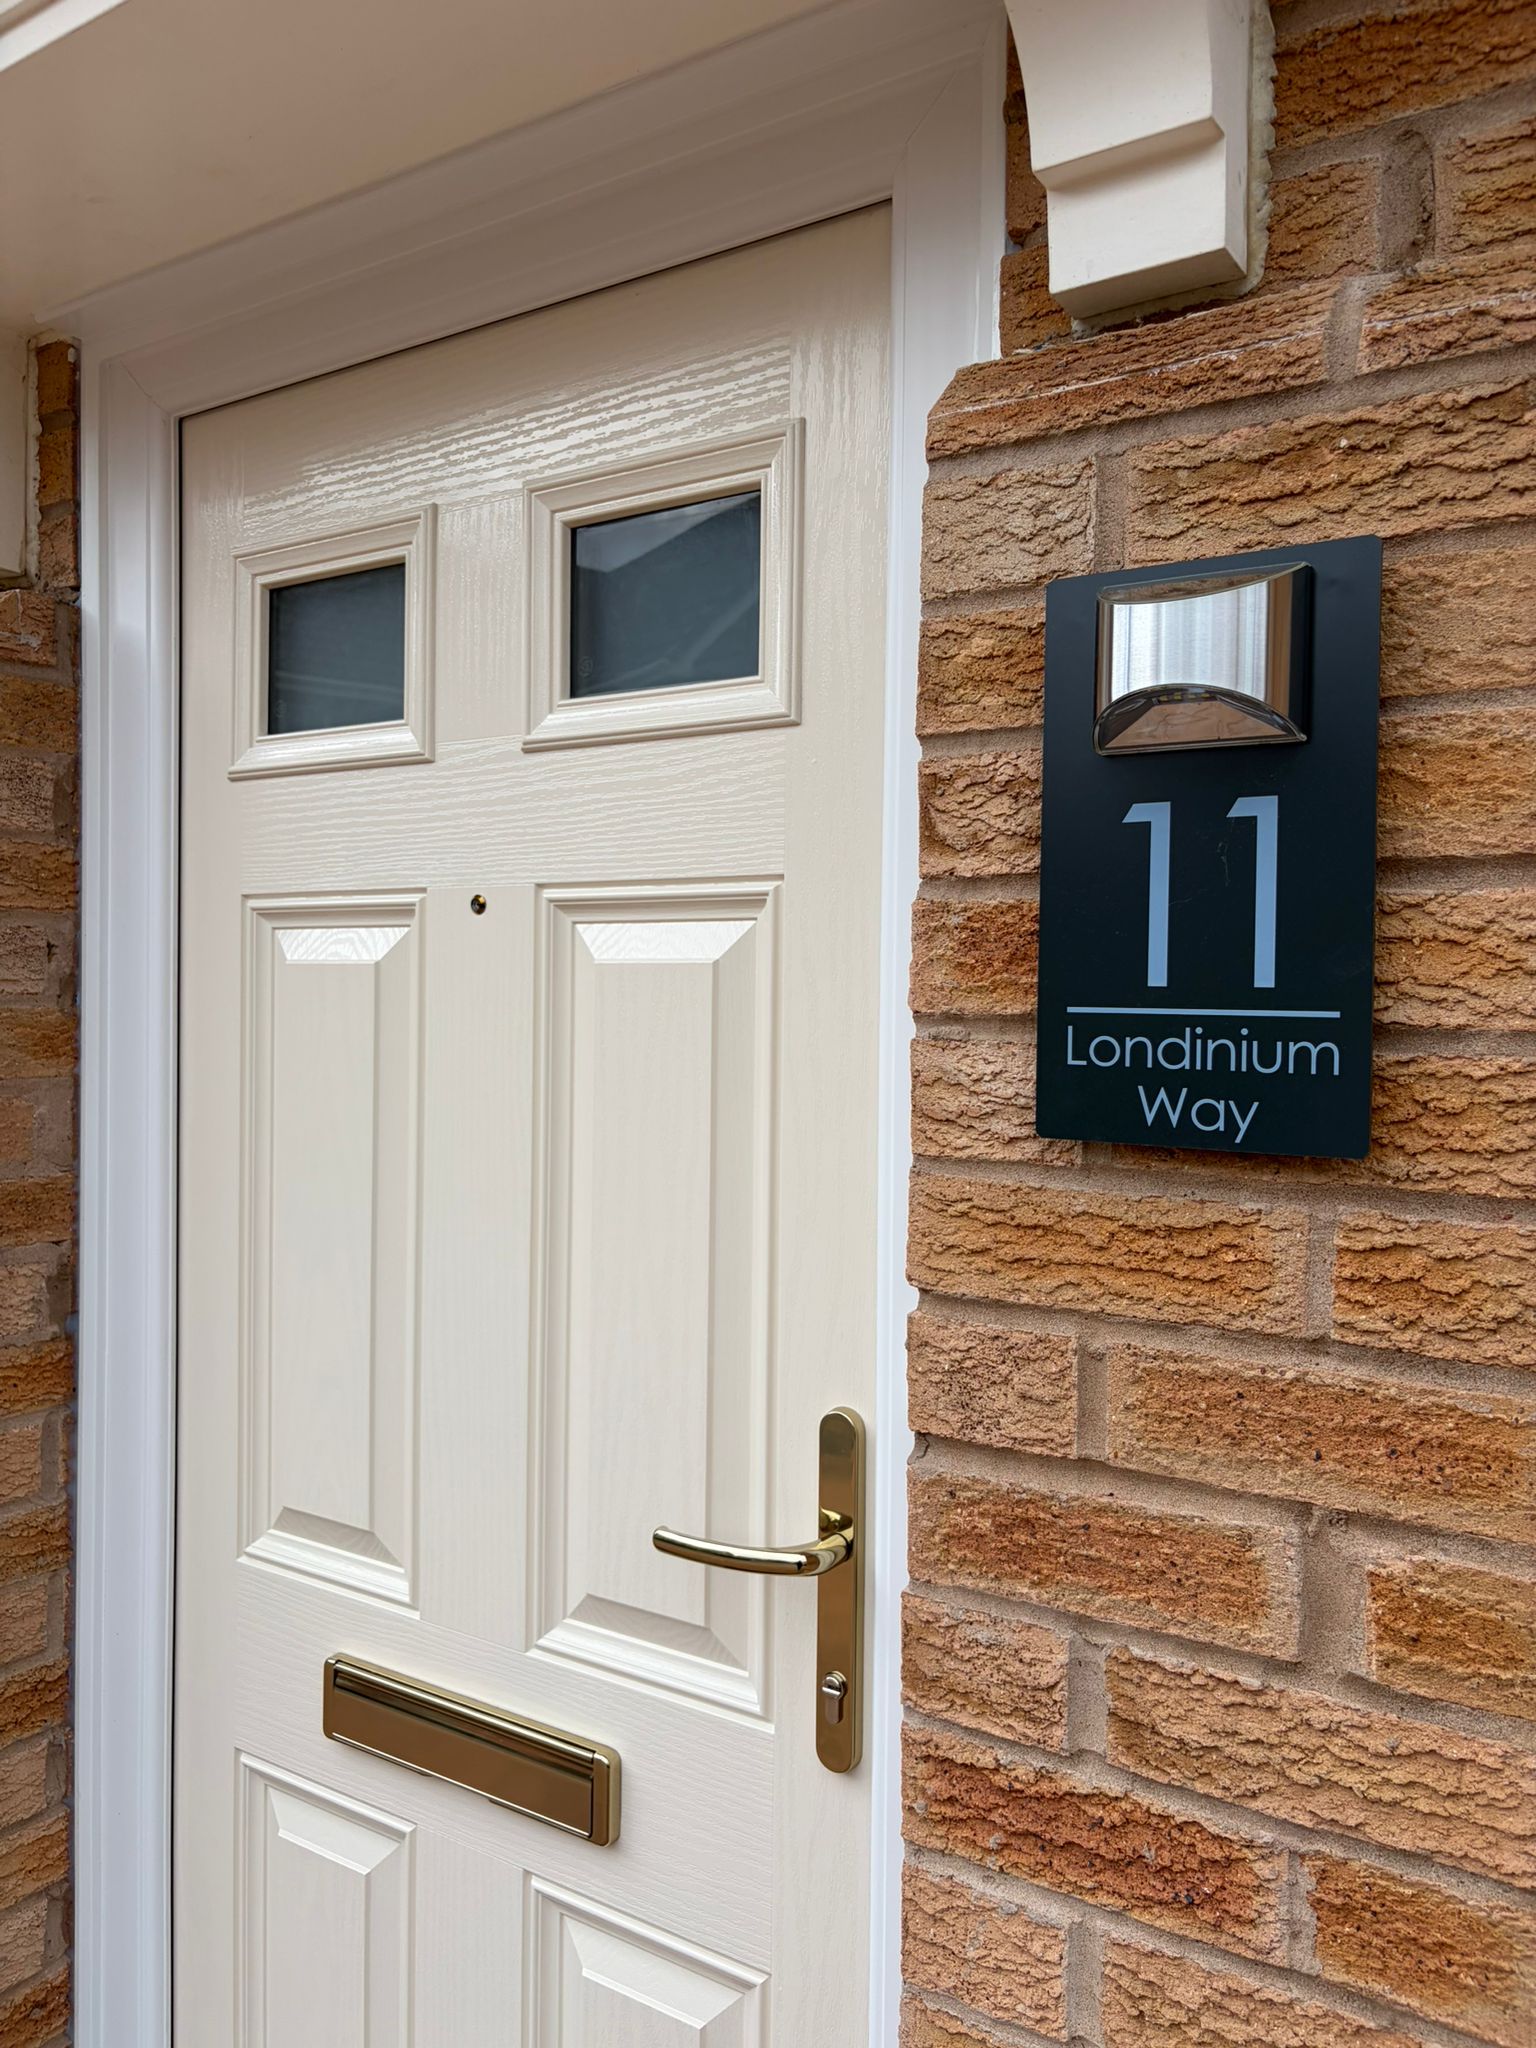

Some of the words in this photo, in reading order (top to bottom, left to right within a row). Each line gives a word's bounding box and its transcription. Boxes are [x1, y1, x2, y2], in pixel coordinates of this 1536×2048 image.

[1121, 795, 1278, 988] 11
[1066, 1025, 1340, 1076] Londinium
[1137, 1085, 1260, 1144] Way
